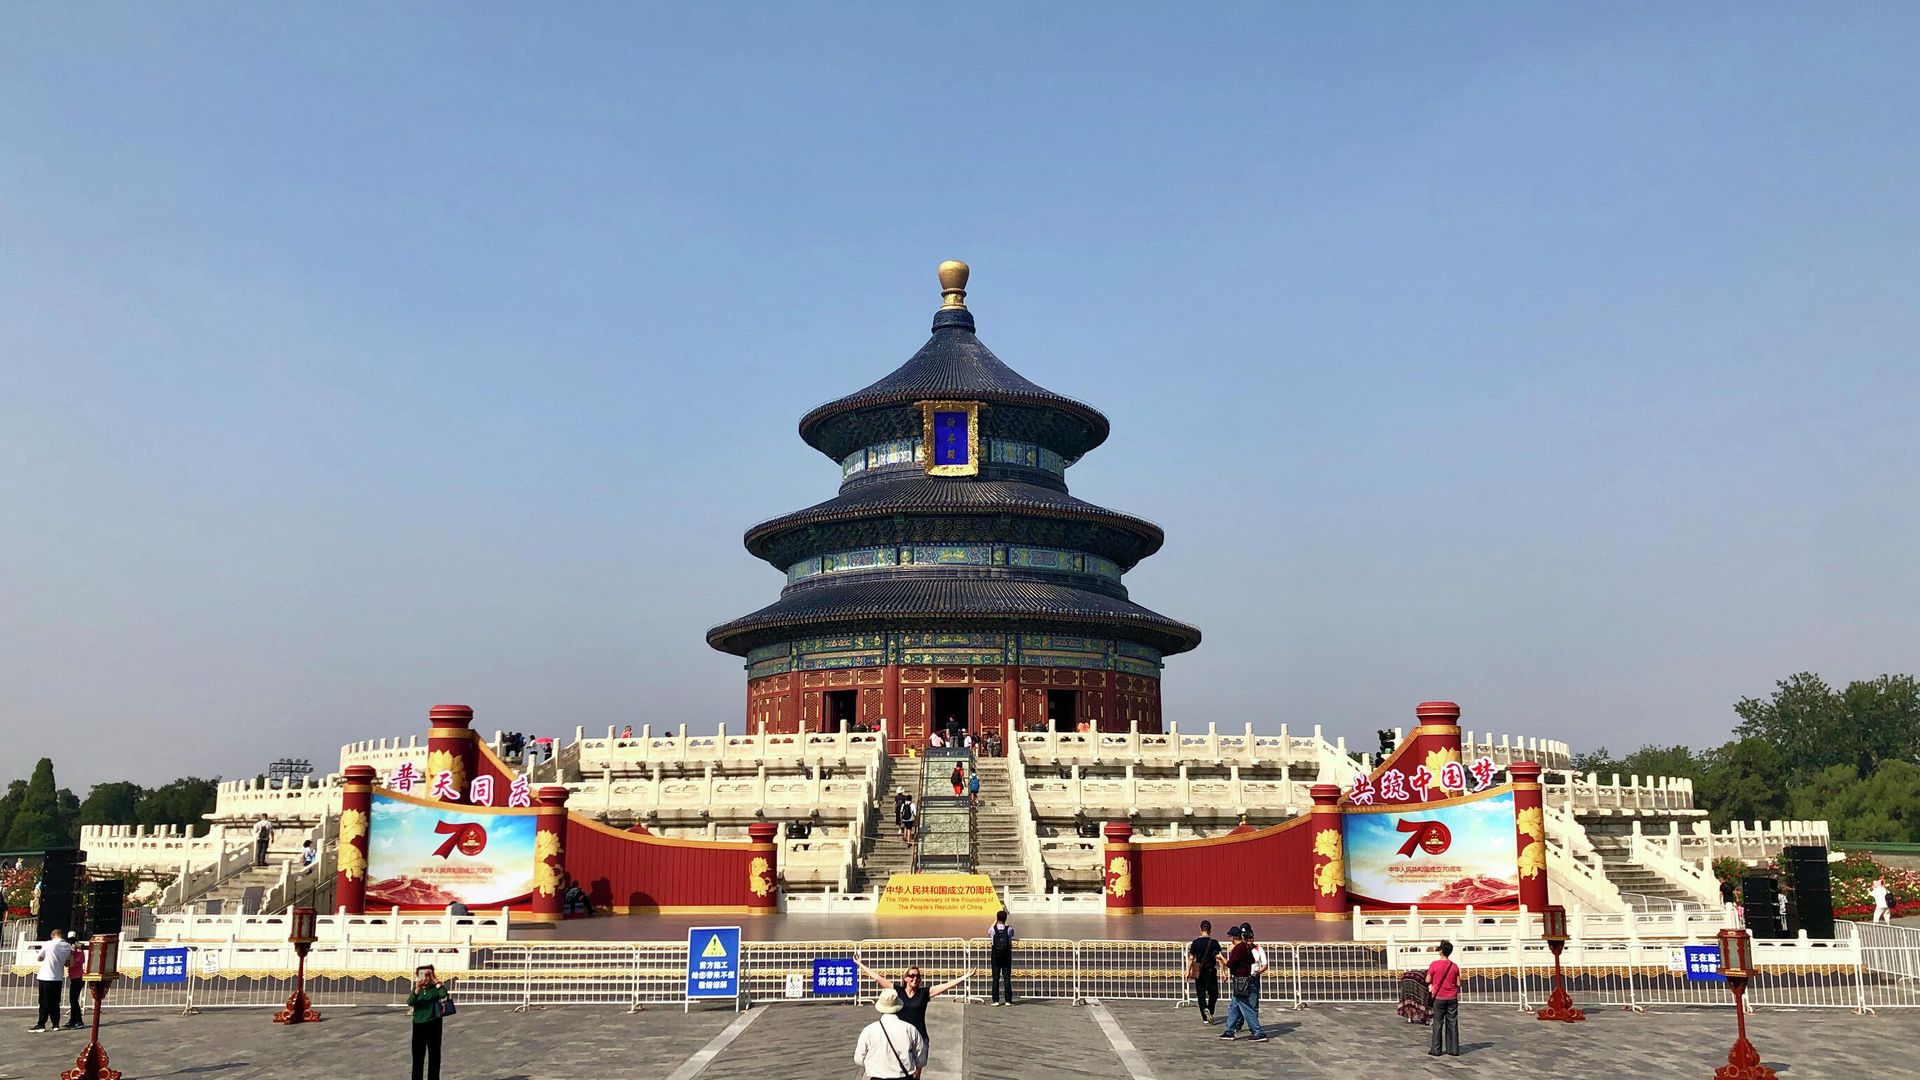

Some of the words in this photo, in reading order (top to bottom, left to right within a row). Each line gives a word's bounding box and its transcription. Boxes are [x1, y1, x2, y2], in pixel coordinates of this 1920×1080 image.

[390, 761, 531, 808] 普天同庆
[1350, 756, 1497, 805] 共筑中国梦
[432, 819, 487, 860] 70
[1396, 818, 1451, 858] 70
[886, 885, 994, 895] 中华人民共和国成立70周年
[149, 955, 183, 965] 正在施工
[148, 965, 183, 976] 请勿靠近
[699, 961, 728, 970] 前方施工
[1691, 963, 1720, 973] 请勿靠
[818, 966, 853, 976] 正在施工
[818, 976, 853, 986] 请勿靠近
